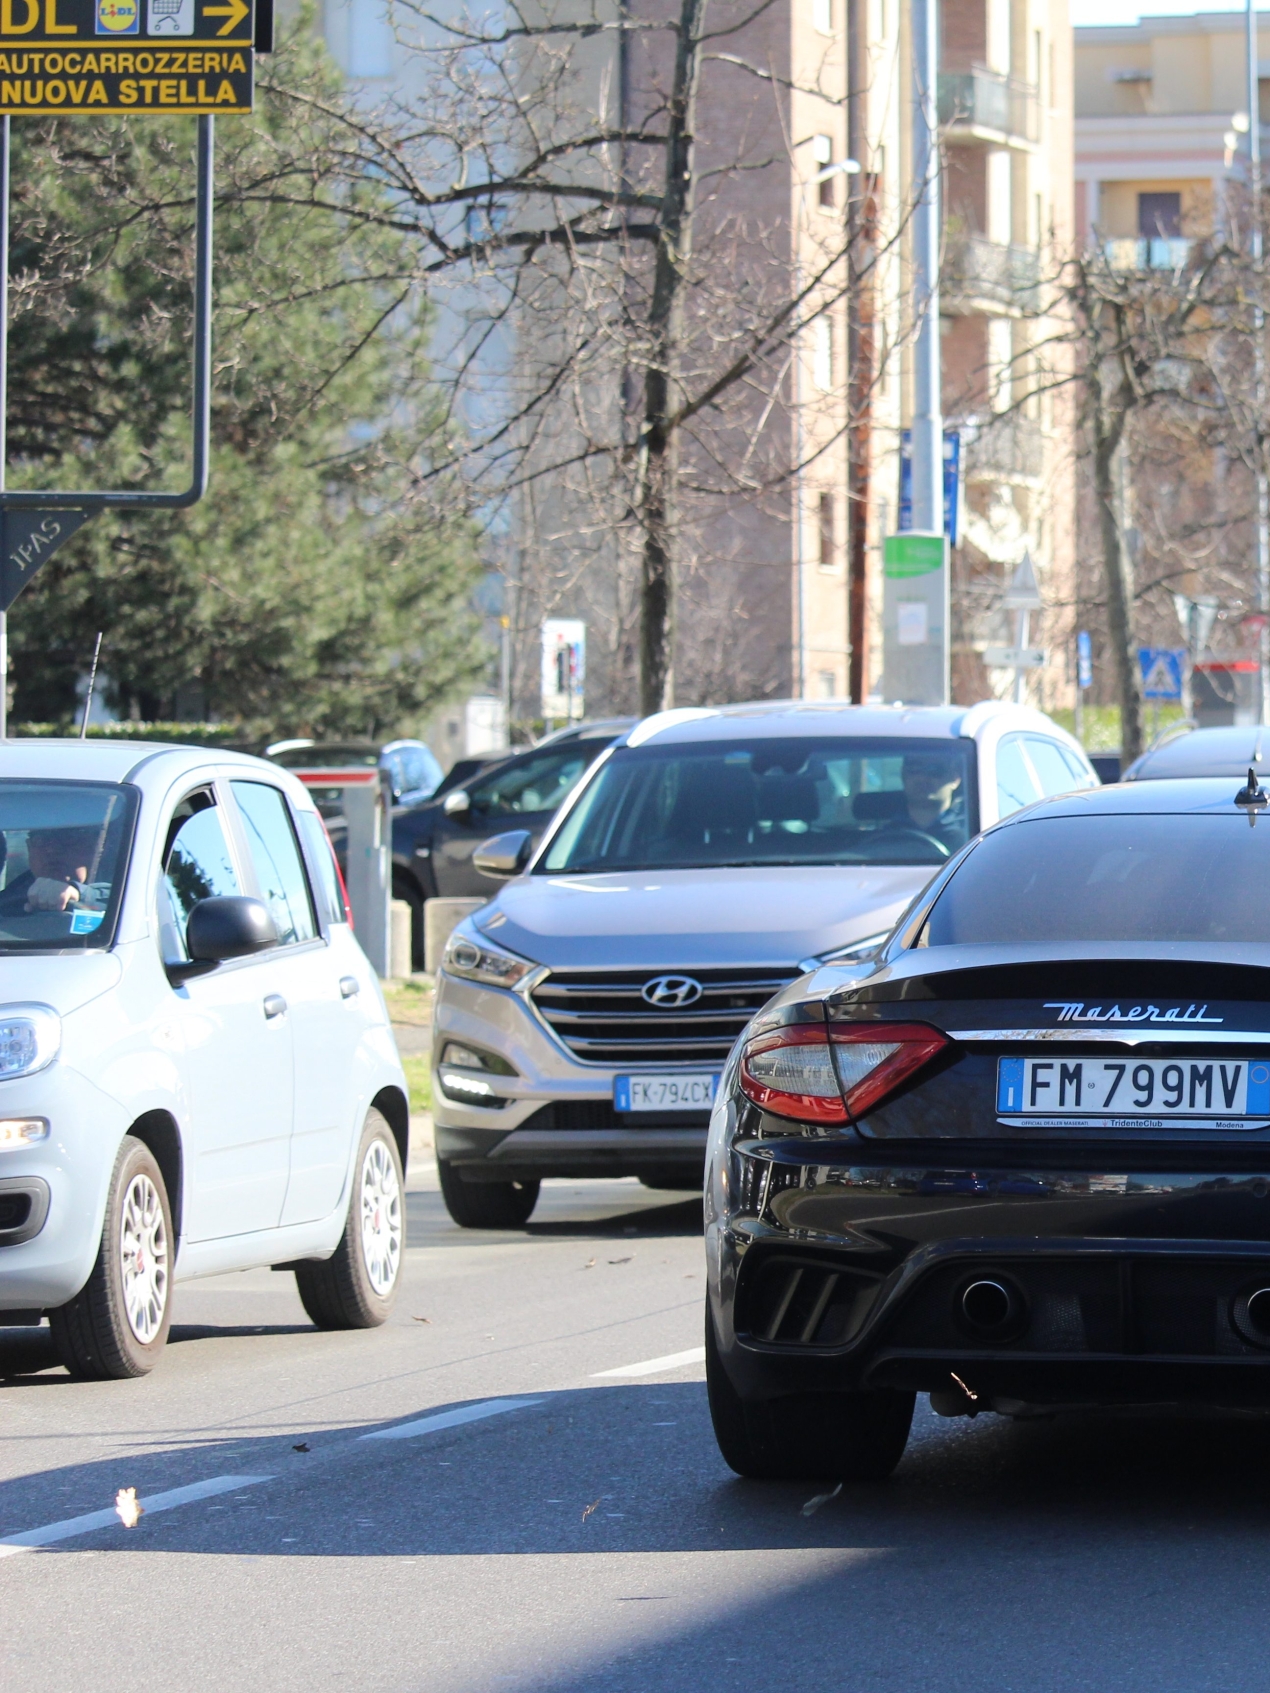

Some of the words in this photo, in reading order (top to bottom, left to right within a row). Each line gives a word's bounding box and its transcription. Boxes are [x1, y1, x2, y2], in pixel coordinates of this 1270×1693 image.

[1, 80, 109, 105] NUOVA
[119, 79, 237, 105] STELLA
[1043, 1003, 1224, 1023] Maserati
[1030, 1063, 1082, 1107] FM
[1102, 1064, 1242, 1109] 799MV
[1110, 1119, 1163, 1127] TridenteClub
[1215, 1121, 1244, 1129] Modena
